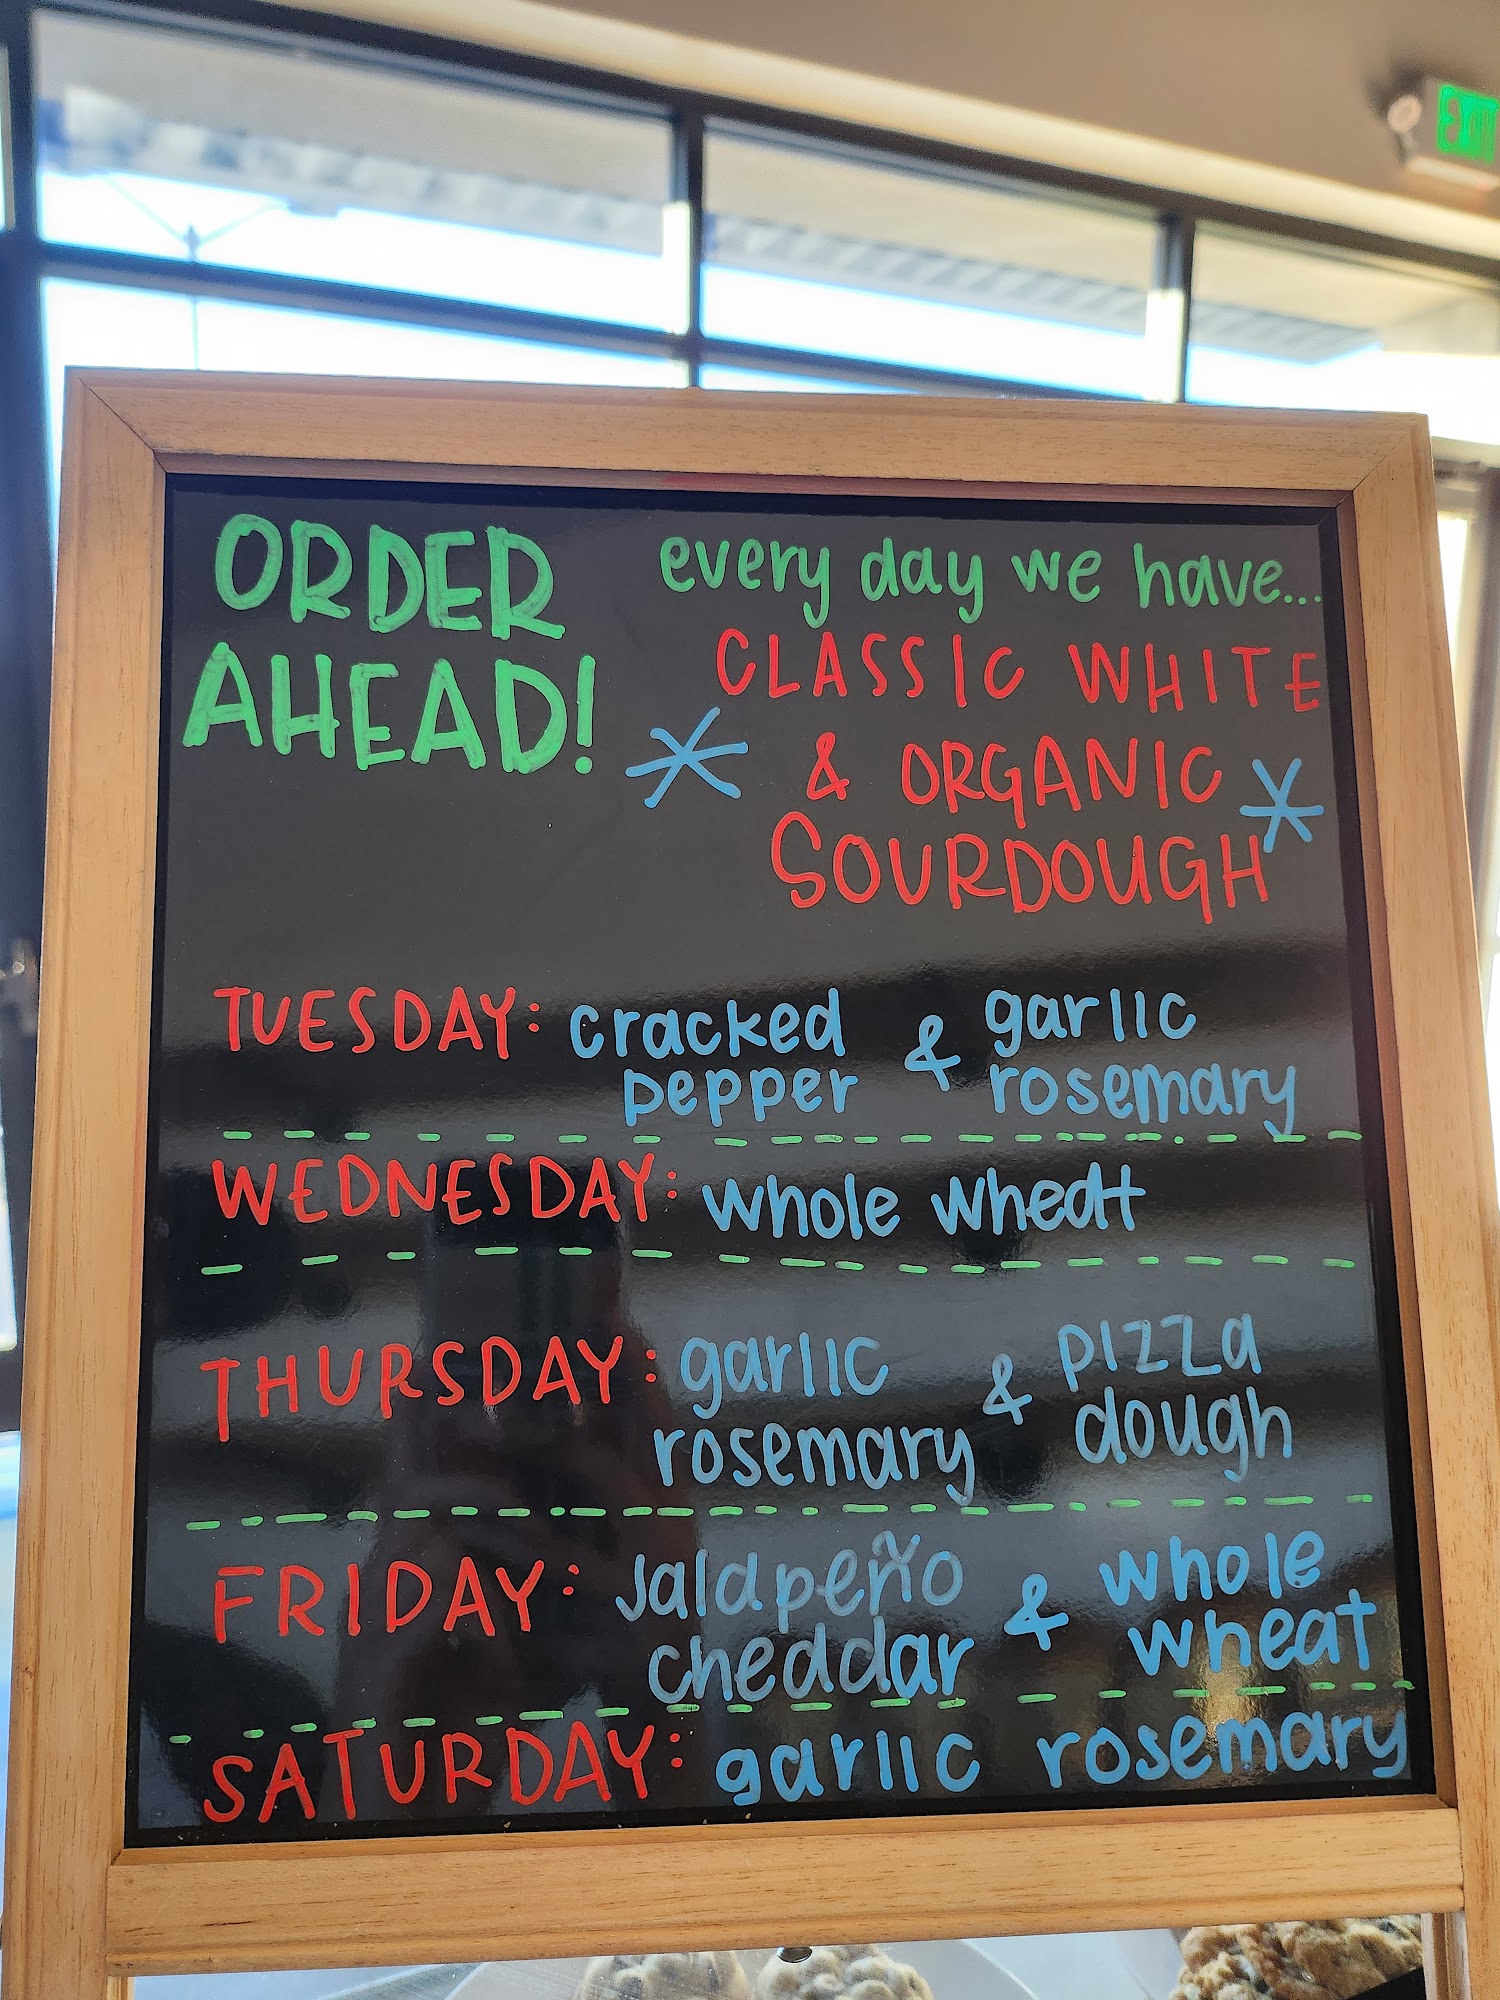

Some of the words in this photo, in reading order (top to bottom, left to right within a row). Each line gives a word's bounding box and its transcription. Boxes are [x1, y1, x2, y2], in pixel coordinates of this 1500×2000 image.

[215, 514, 565, 640] ORDER
[660, 537, 830, 627] every
[862, 538, 983, 622] day
[1012, 550, 1100, 600] we
[1134, 544, 1323, 607] have...
[182, 641, 594, 774] AHEAD!
[717, 628, 1024, 707] CLASSIC
[1068, 642, 1321, 712] WHITE
[807, 732, 848, 800] &
[902, 735, 1221, 829] ORGANIC
[772, 811, 1269, 924] SOURDOUGH
[213, 987, 538, 1059] TUESDAY:
[570, 989, 845, 1058] cracked
[906, 1015, 961, 1089] &
[986, 990, 1196, 1056] garlic
[624, 1067, 858, 1126] pepper
[990, 1065, 1296, 1135] rosemary
[212, 1153, 675, 1224] WEDNESDAY:
[702, 1173, 900, 1238] whole
[932, 1163, 1146, 1234] wheat
[200, 1336, 656, 1441] THURSDAY:
[679, 1334, 890, 1418] garlic
[983, 1355, 1032, 1424] &
[1058, 1315, 1262, 1391] pizza
[654, 1423, 976, 1504] rosemary
[1075, 1386, 1293, 1483] dough
[214, 1557, 579, 1643] FRIDAY:
[1004, 1572, 1069, 1651] &
[1098, 1529, 1326, 1606] whole
[649, 1616, 975, 1703] cheddar
[1127, 1588, 1376, 1676] wheat
[204, 1721, 682, 1822] SATURDAY:
[716, 1730, 980, 1806] garlic
[1037, 1712, 1407, 1789] rosemary
